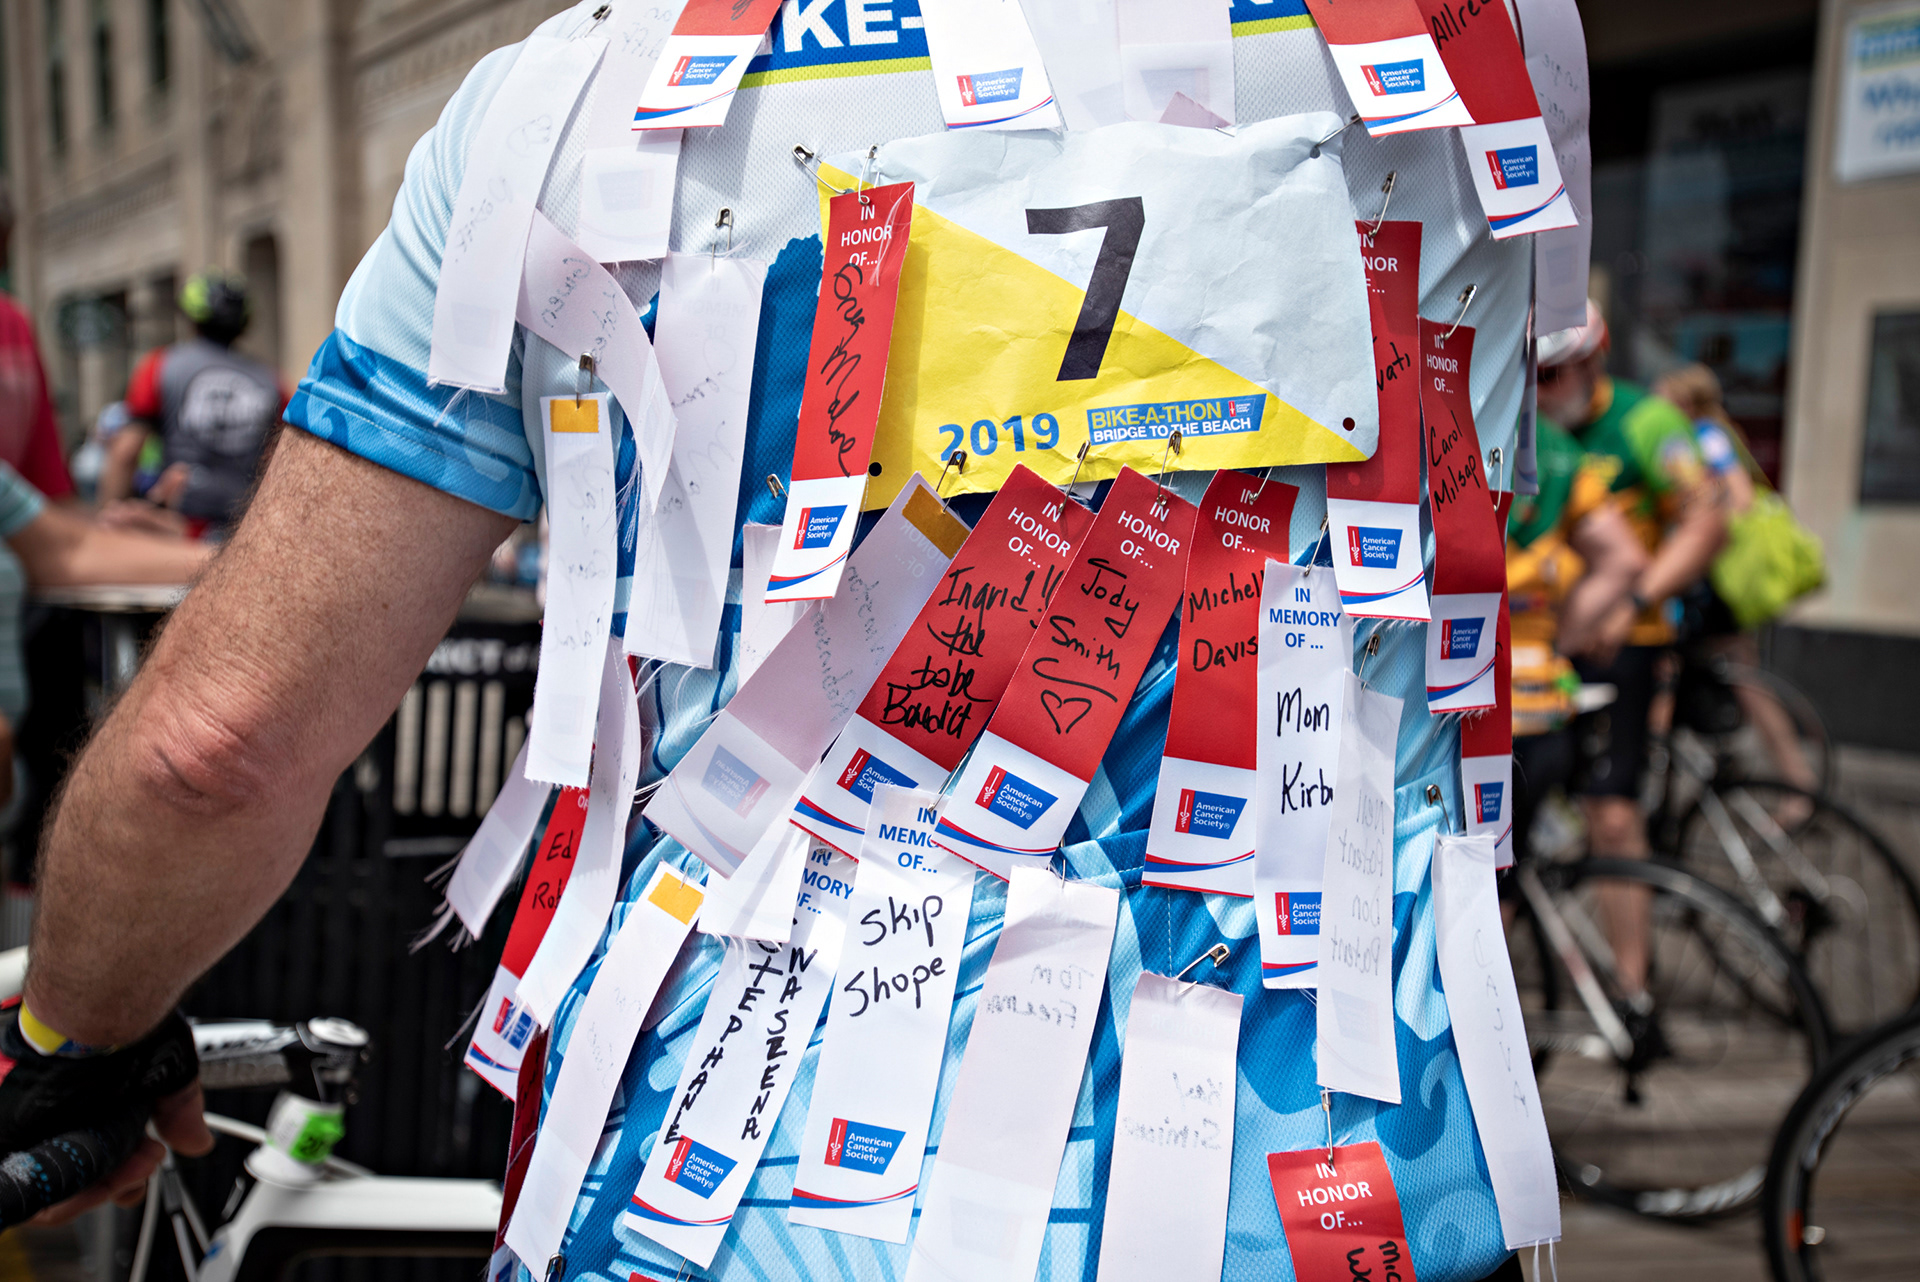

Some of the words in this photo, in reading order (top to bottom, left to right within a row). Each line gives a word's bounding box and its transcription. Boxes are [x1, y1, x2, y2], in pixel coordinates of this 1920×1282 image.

[781, 0, 925, 53] KE-
[1381, 68, 1419, 77] American
[1502, 156, 1534, 165] American
[1503, 164, 1526, 172] Cancer
[860, 205, 875, 221] IN
[841, 225, 893, 247] HONOR
[1362, 256, 1398, 272] NOR
[1025, 196, 1146, 381] 7
[1434, 335, 1444, 349] IN
[1426, 354, 1459, 374] HONOR
[1091, 402, 1222, 429] BIKE-A-THON
[938, 412, 1060, 462] 2019
[1093, 426, 1147, 442] BRIDGE
[1149, 425, 1169, 438] TO
[1171, 422, 1199, 436] THE
[1202, 417, 1251, 433] BEACH
[1430, 410, 1463, 467] Carol
[1433, 455, 1481, 513] Milsap
[1240, 488, 1254, 506] IN
[810, 516, 838, 524] American
[1042, 502, 1062, 523] IN
[1149, 503, 1170, 522] IN
[1214, 506, 1271, 533] HONOR
[1008, 507, 1071, 558] HONOR
[1117, 510, 1181, 555] HONOR
[1362, 537, 1396, 545] American
[1363, 544, 1387, 552] Cancer
[1081, 558, 1139, 638] Jody
[1295, 587, 1311, 603] IN
[1269, 608, 1341, 627] MEMORY
[1452, 627, 1479, 635] American
[1049, 615, 1120, 680] Smith
[1193, 636, 1259, 672] Davis
[1277, 687, 1330, 737] Mom
[999, 789, 1029, 810] Cancer
[1003, 783, 1043, 809] American
[917, 807, 937, 825] IN
[1194, 810, 1223, 820] Cancer
[1196, 802, 1236, 815] American
[546, 829, 574, 861] Ed
[811, 849, 832, 866] IN
[802, 867, 854, 900] MORY
[1292, 901, 1321, 910] Americ
[860, 895, 943, 948] Skip
[844, 957, 946, 1017] Shope
[664, 940, 785, 1146] TEPHANIE
[846, 1141, 879, 1154] Cancer
[848, 1132, 893, 1149] American
[686, 1160, 711, 1178] Cancer
[689, 1152, 724, 1175] American
[1315, 1163, 1338, 1179] IN
[1297, 1181, 1373, 1207] HONOR
